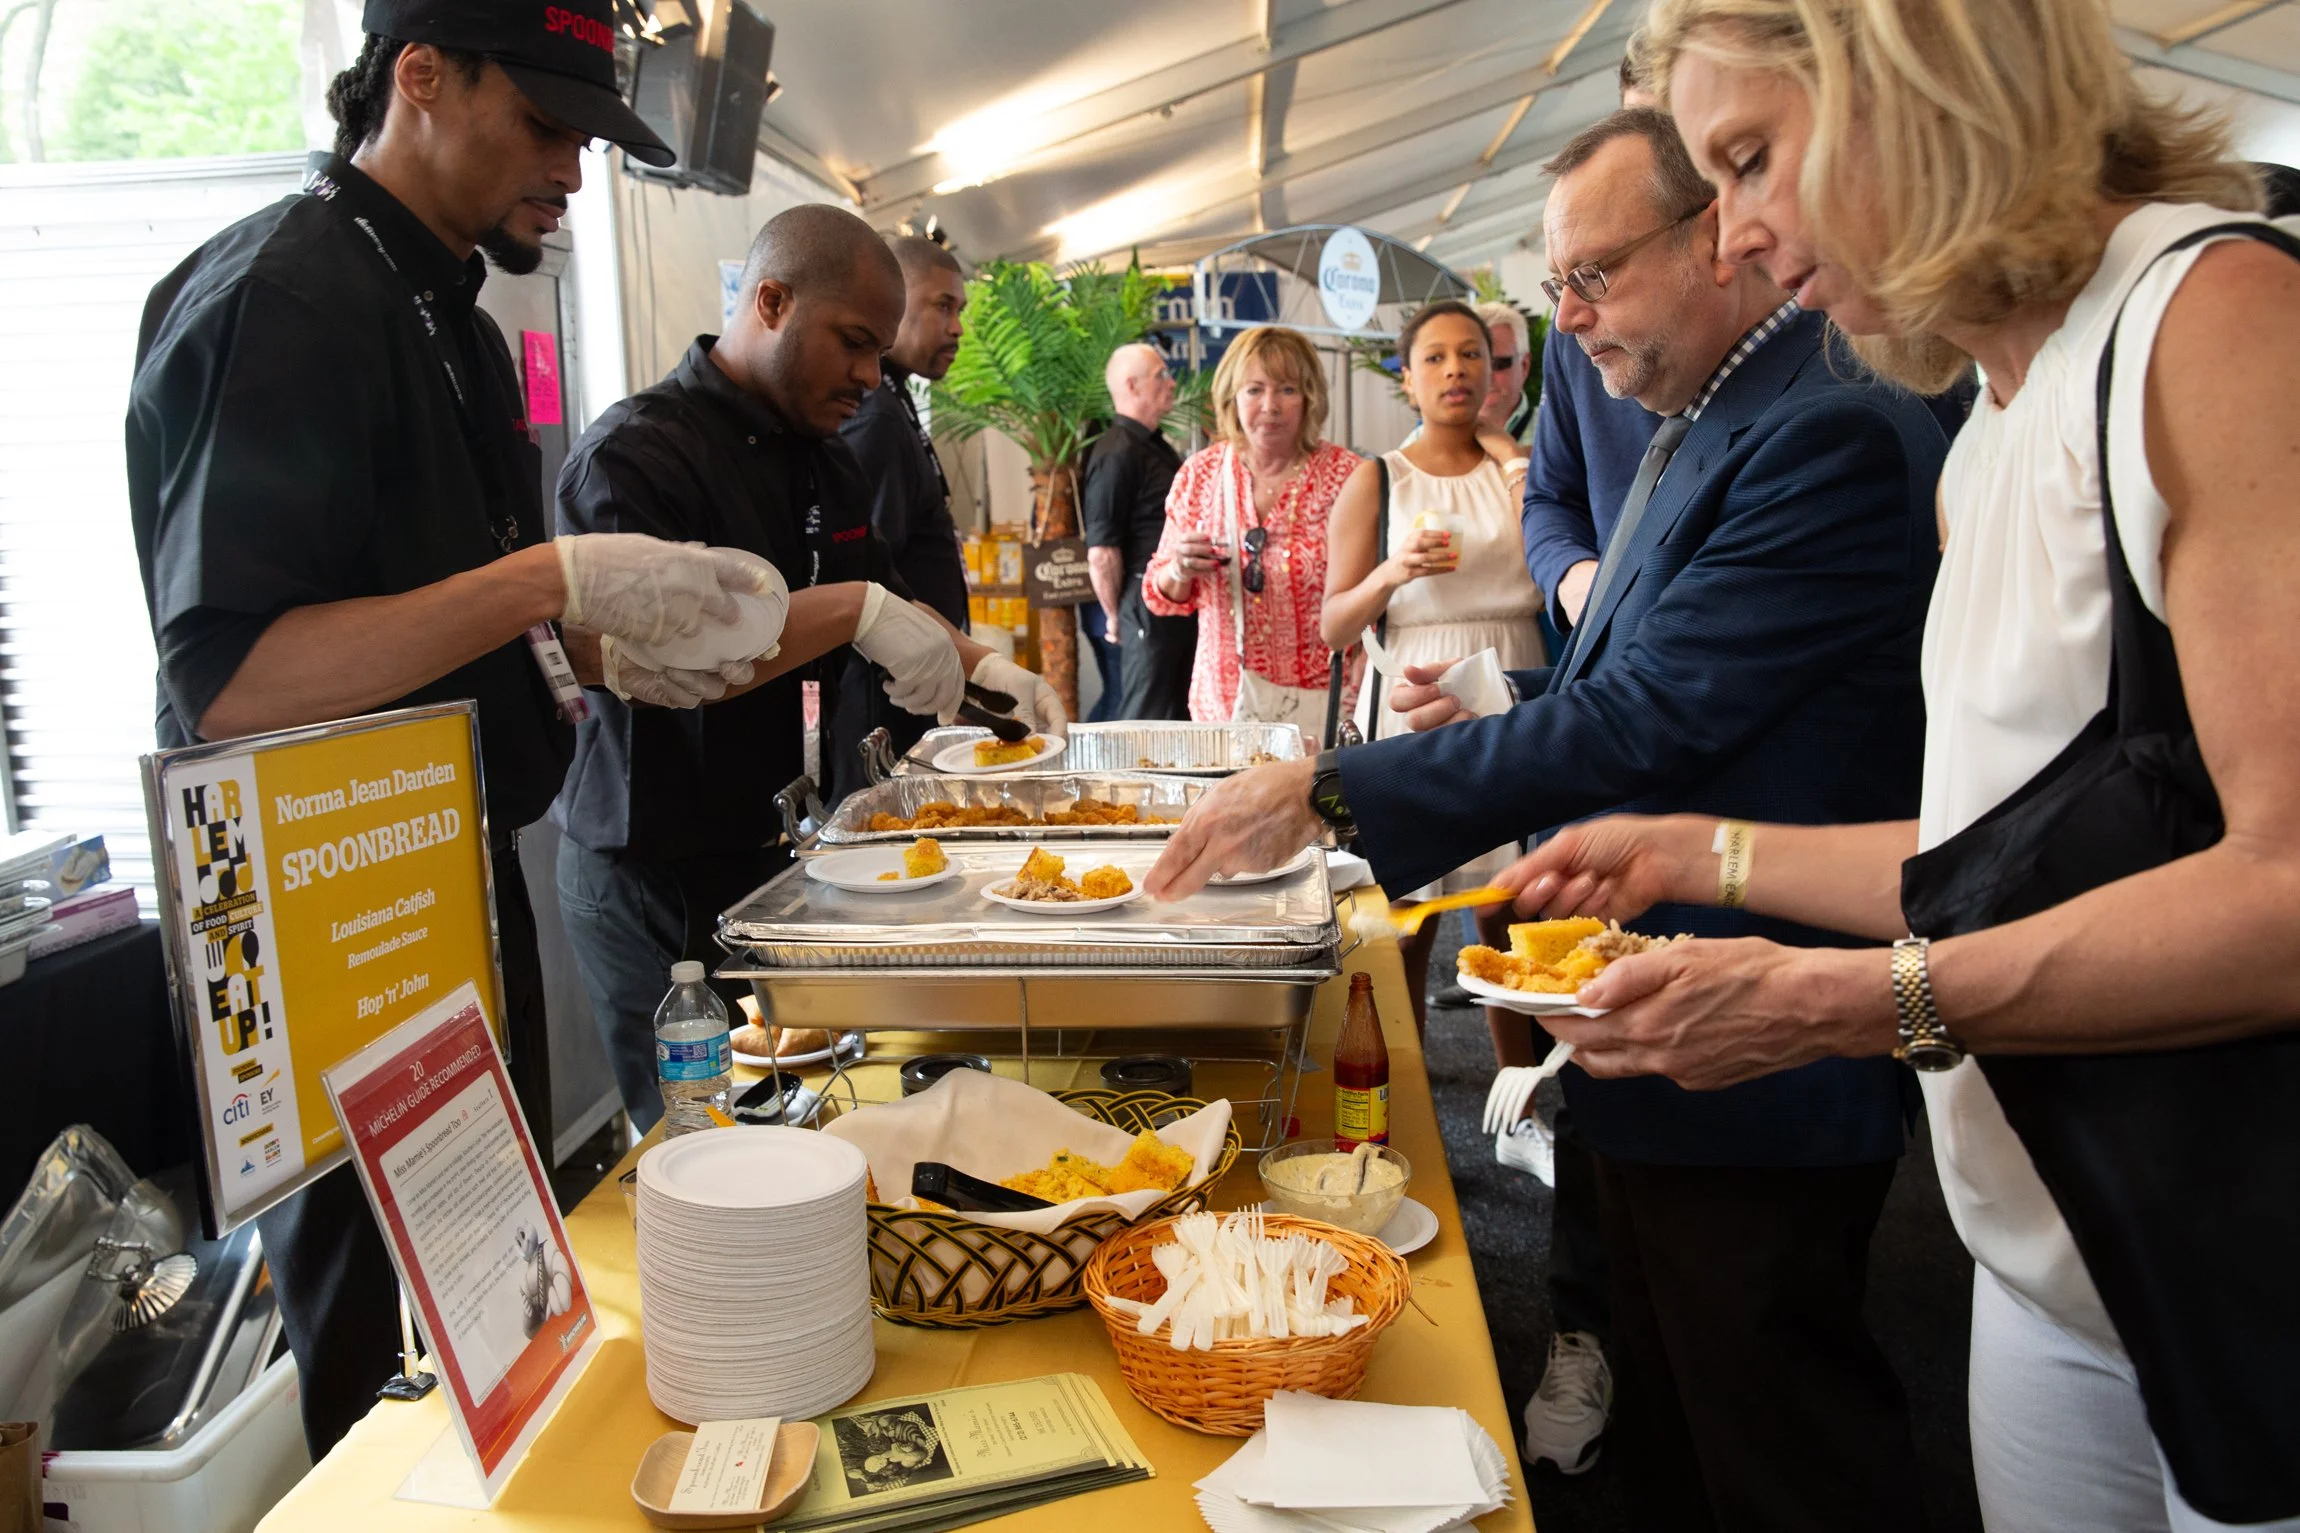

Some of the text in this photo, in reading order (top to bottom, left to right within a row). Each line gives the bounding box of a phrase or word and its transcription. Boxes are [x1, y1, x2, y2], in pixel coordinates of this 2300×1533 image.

[1324, 267, 1375, 293] Corona
[275, 762, 456, 825] Norma Jean Darden
[282, 807, 461, 892] SPOONBREAD
[1726, 832, 1741, 879] HARLEM
[204, 893, 256, 915] CELEBRATION
[331, 888, 435, 943] Louisiana Catfish
[193, 921, 204, 932] OF
[205, 915, 227, 929] FOOD
[208, 919, 252, 940] AND SPIRIT
[347, 927, 428, 969] Remoulade Sauce
[357, 994, 384, 1019] Hop
[400, 973, 429, 1000] John
[409, 1060, 424, 1081] 20
[260, 1088, 274, 1106] EY
[369, 1045, 481, 1137] MICHELIN GUIDE RECOMMENDED
[223, 1098, 250, 1125] citi
[394, 1164, 407, 1179] Miss
